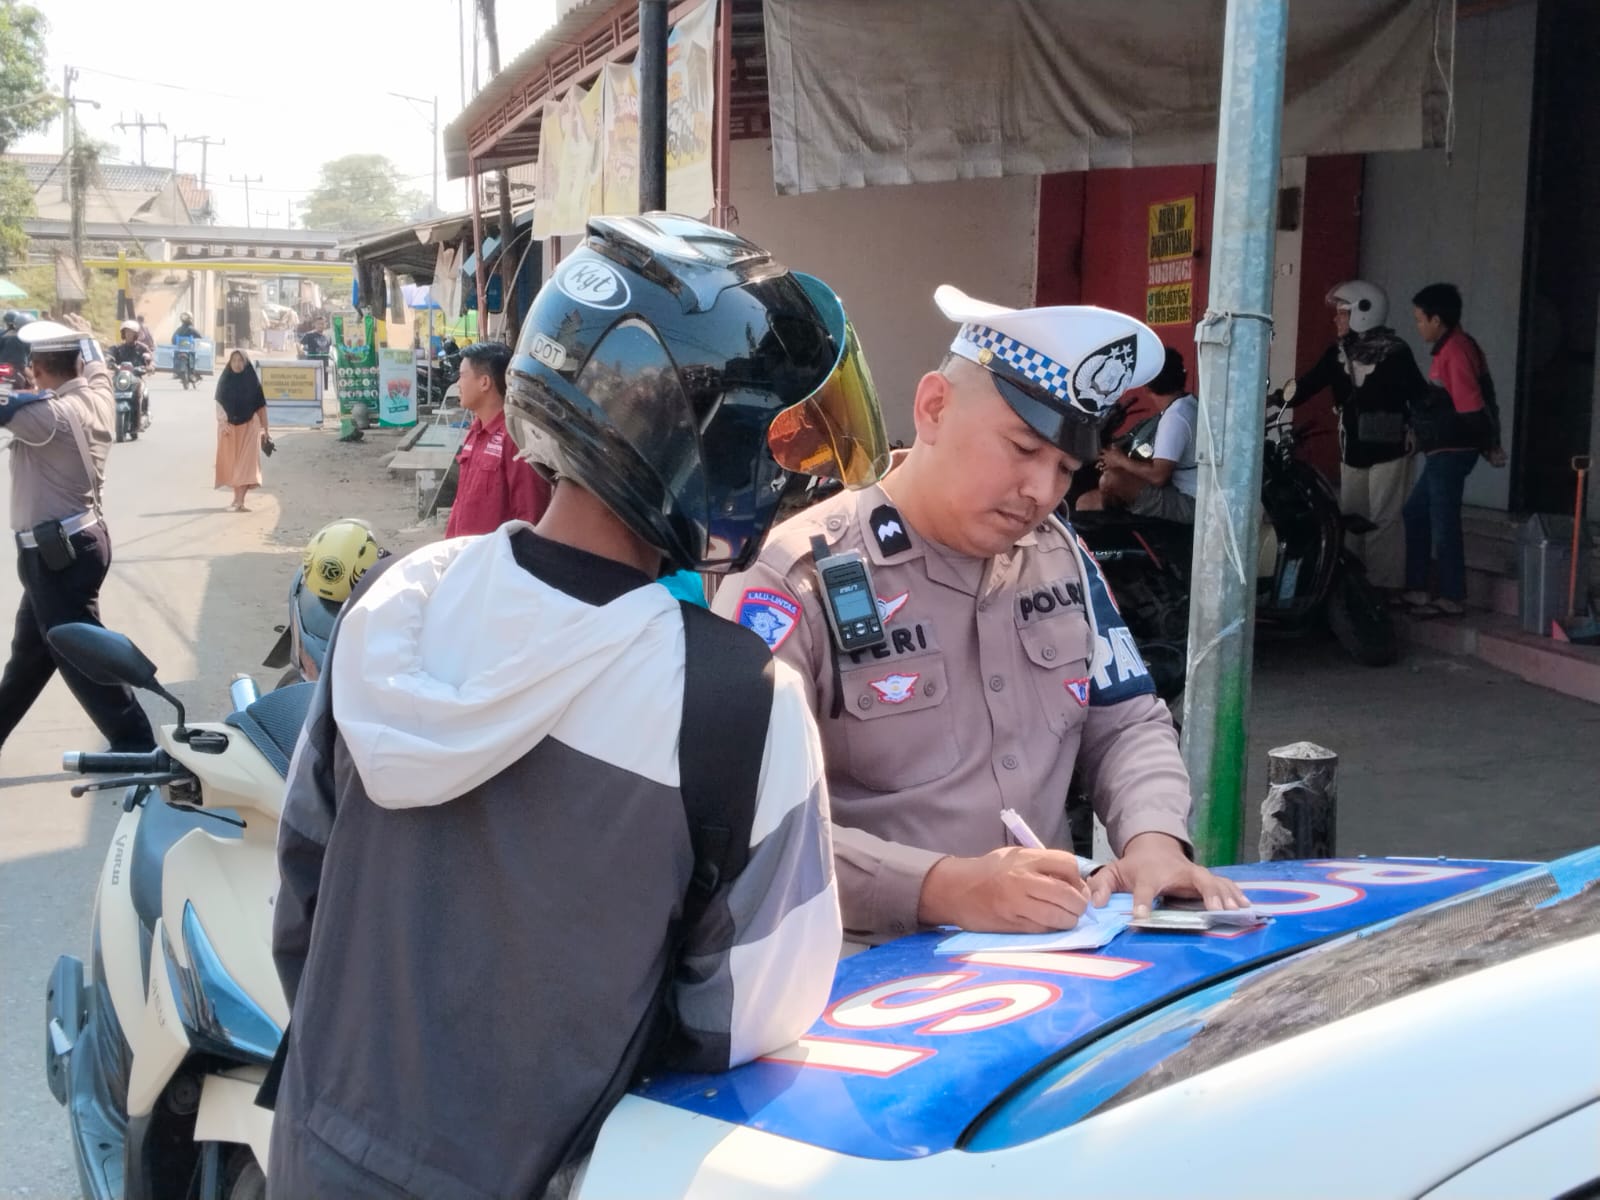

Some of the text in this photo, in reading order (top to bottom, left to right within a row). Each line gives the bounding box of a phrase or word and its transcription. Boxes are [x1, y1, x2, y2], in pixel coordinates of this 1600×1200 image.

[534, 338, 562, 364] DOT
[748, 591, 798, 615] LALU-LINTAS
[757, 861, 1488, 1079] POISI
